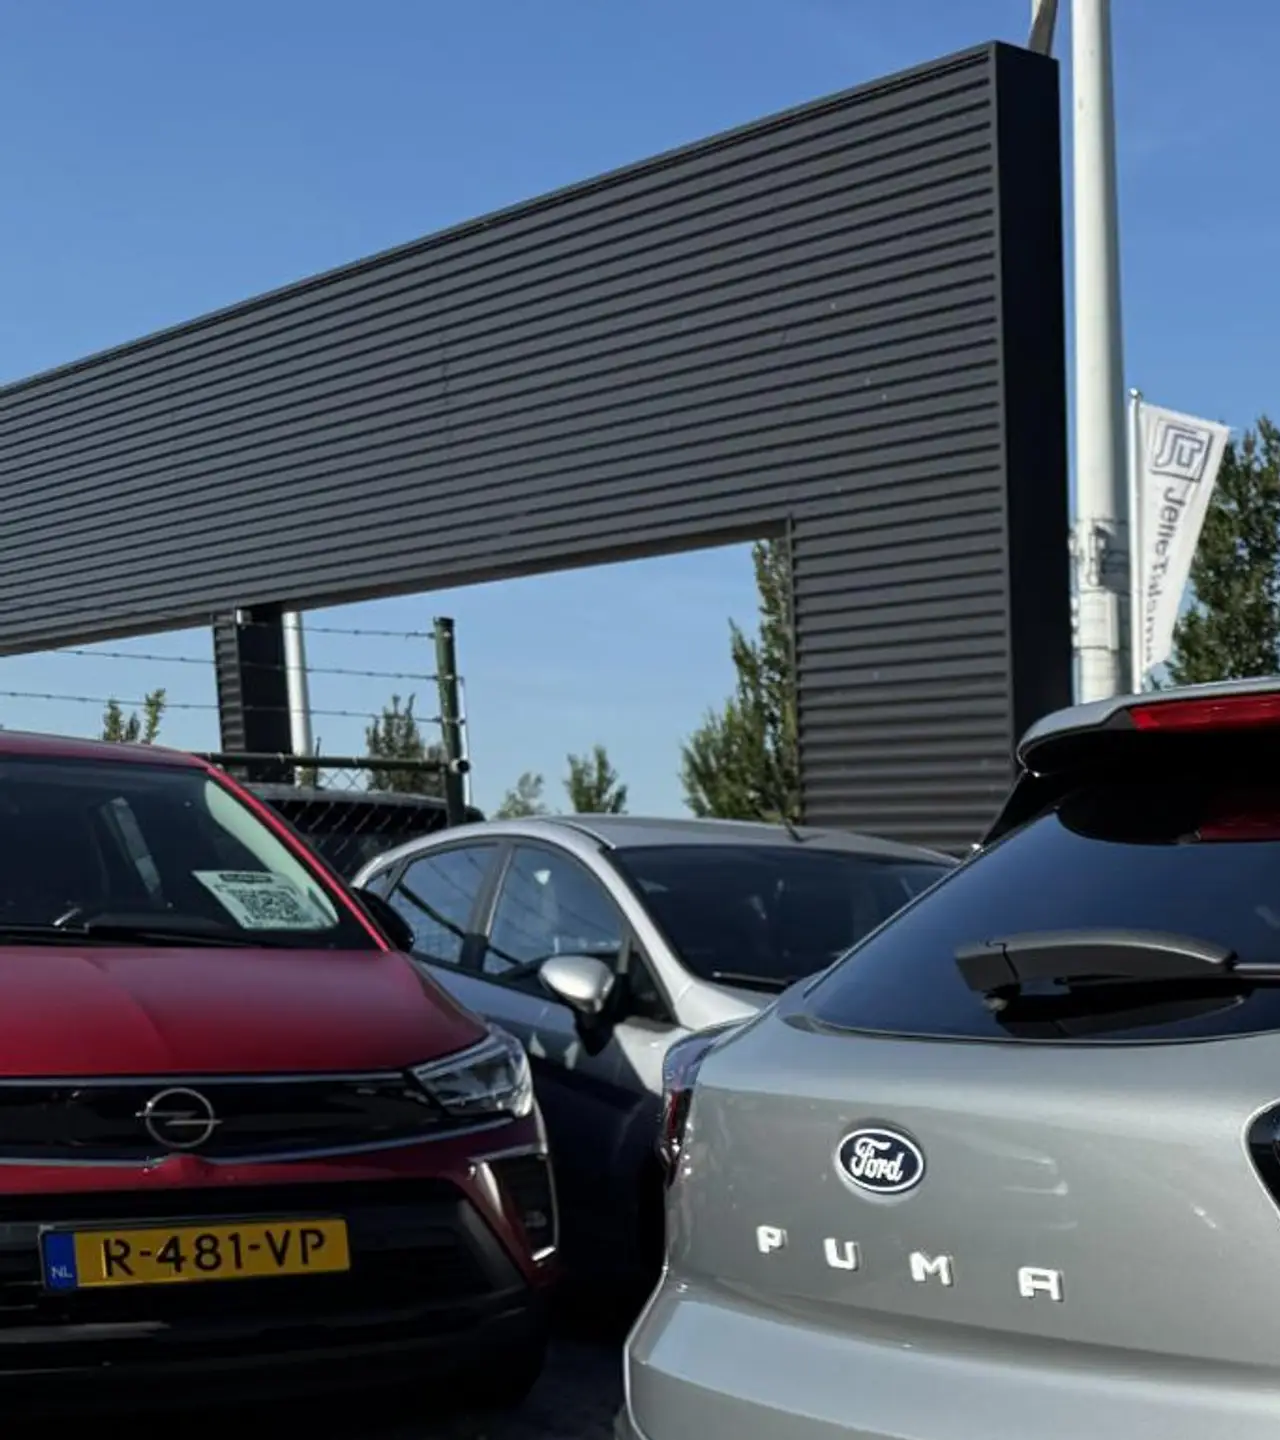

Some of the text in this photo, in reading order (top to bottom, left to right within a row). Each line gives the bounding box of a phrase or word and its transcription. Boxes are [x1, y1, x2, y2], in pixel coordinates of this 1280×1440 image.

[1155, 486, 1186, 557] Jelle
[850, 1135, 905, 1183] Ford
[51, 1265, 73, 1280] NL
[101, 1228, 325, 1279] R-481-VP
[756, 1225, 1065, 1302] PUMA
